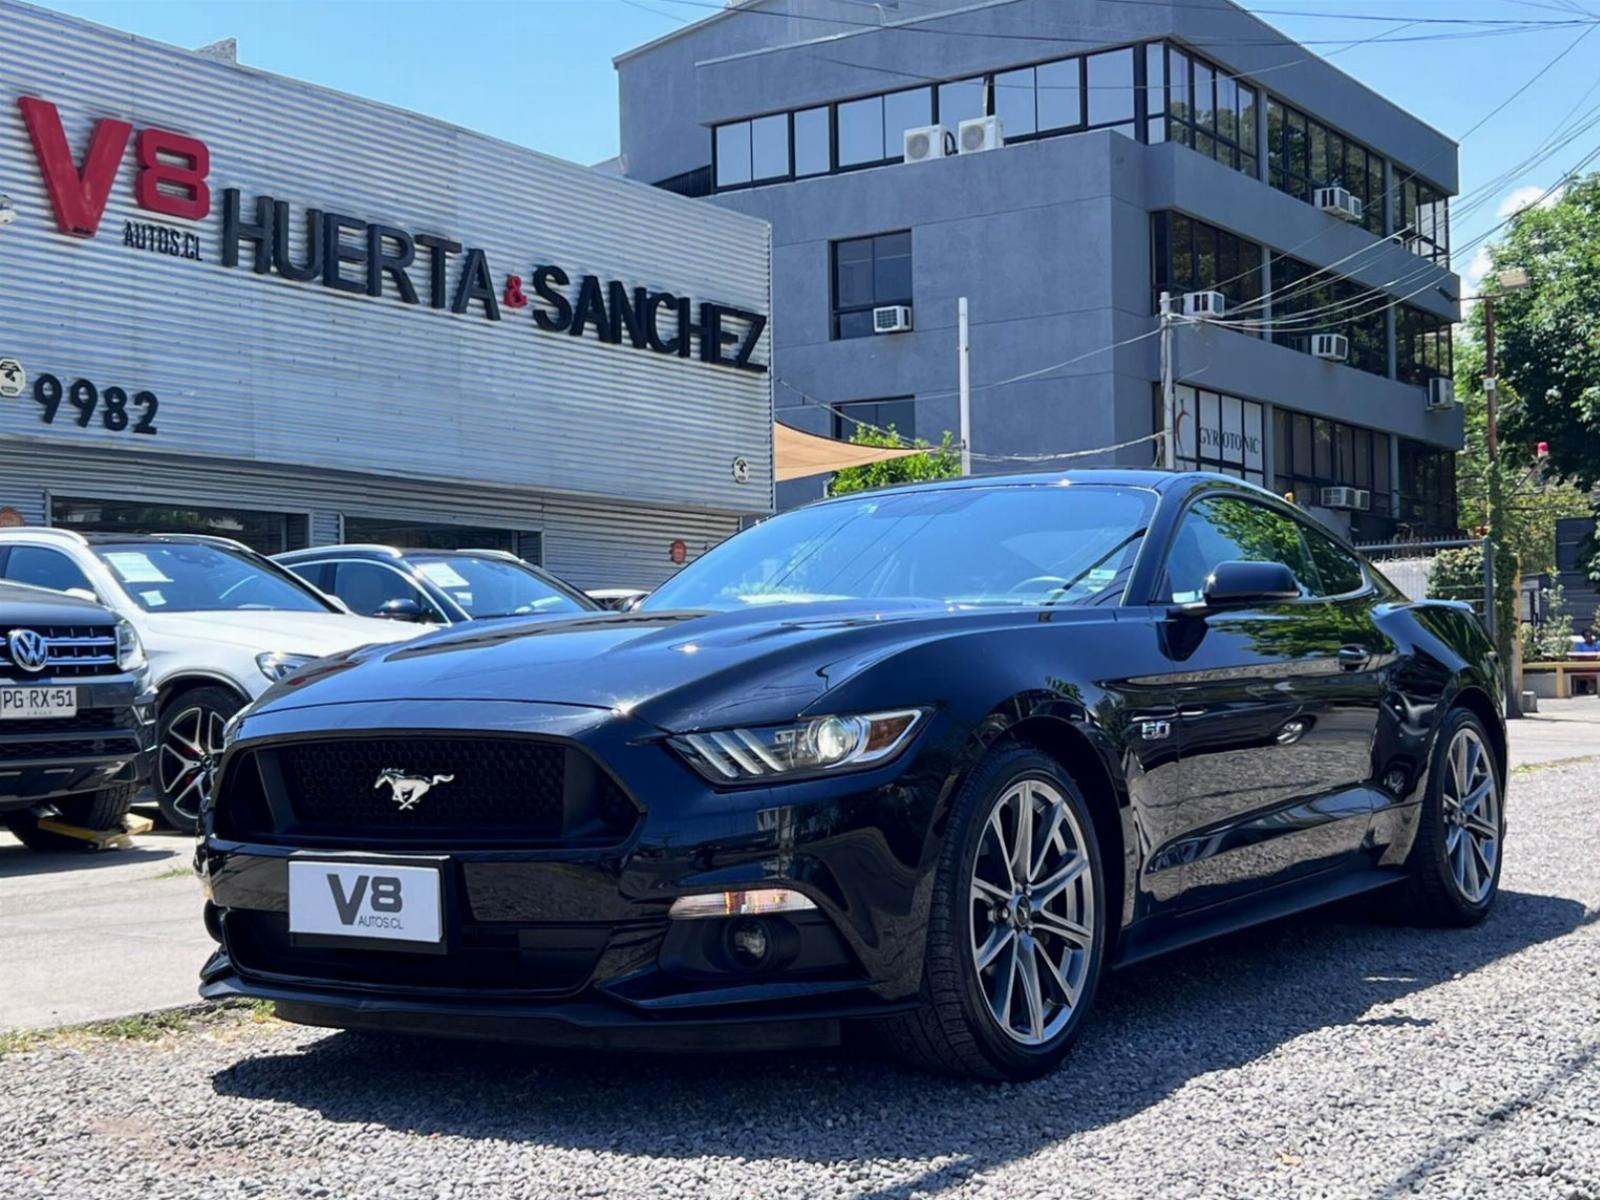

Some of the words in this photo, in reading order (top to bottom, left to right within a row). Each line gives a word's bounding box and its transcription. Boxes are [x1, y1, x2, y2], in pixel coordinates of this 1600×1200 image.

[18, 95, 210, 238] V8
[123, 220, 203, 262] AUTOS.CL
[221, 187, 501, 321] HUERTA
[504, 274, 528, 308] &
[532, 264, 768, 373] SANCHEZ
[33, 372, 159, 436] 9982
[326, 873, 403, 925] V8
[358, 915, 404, 930] AUTOS.CL
